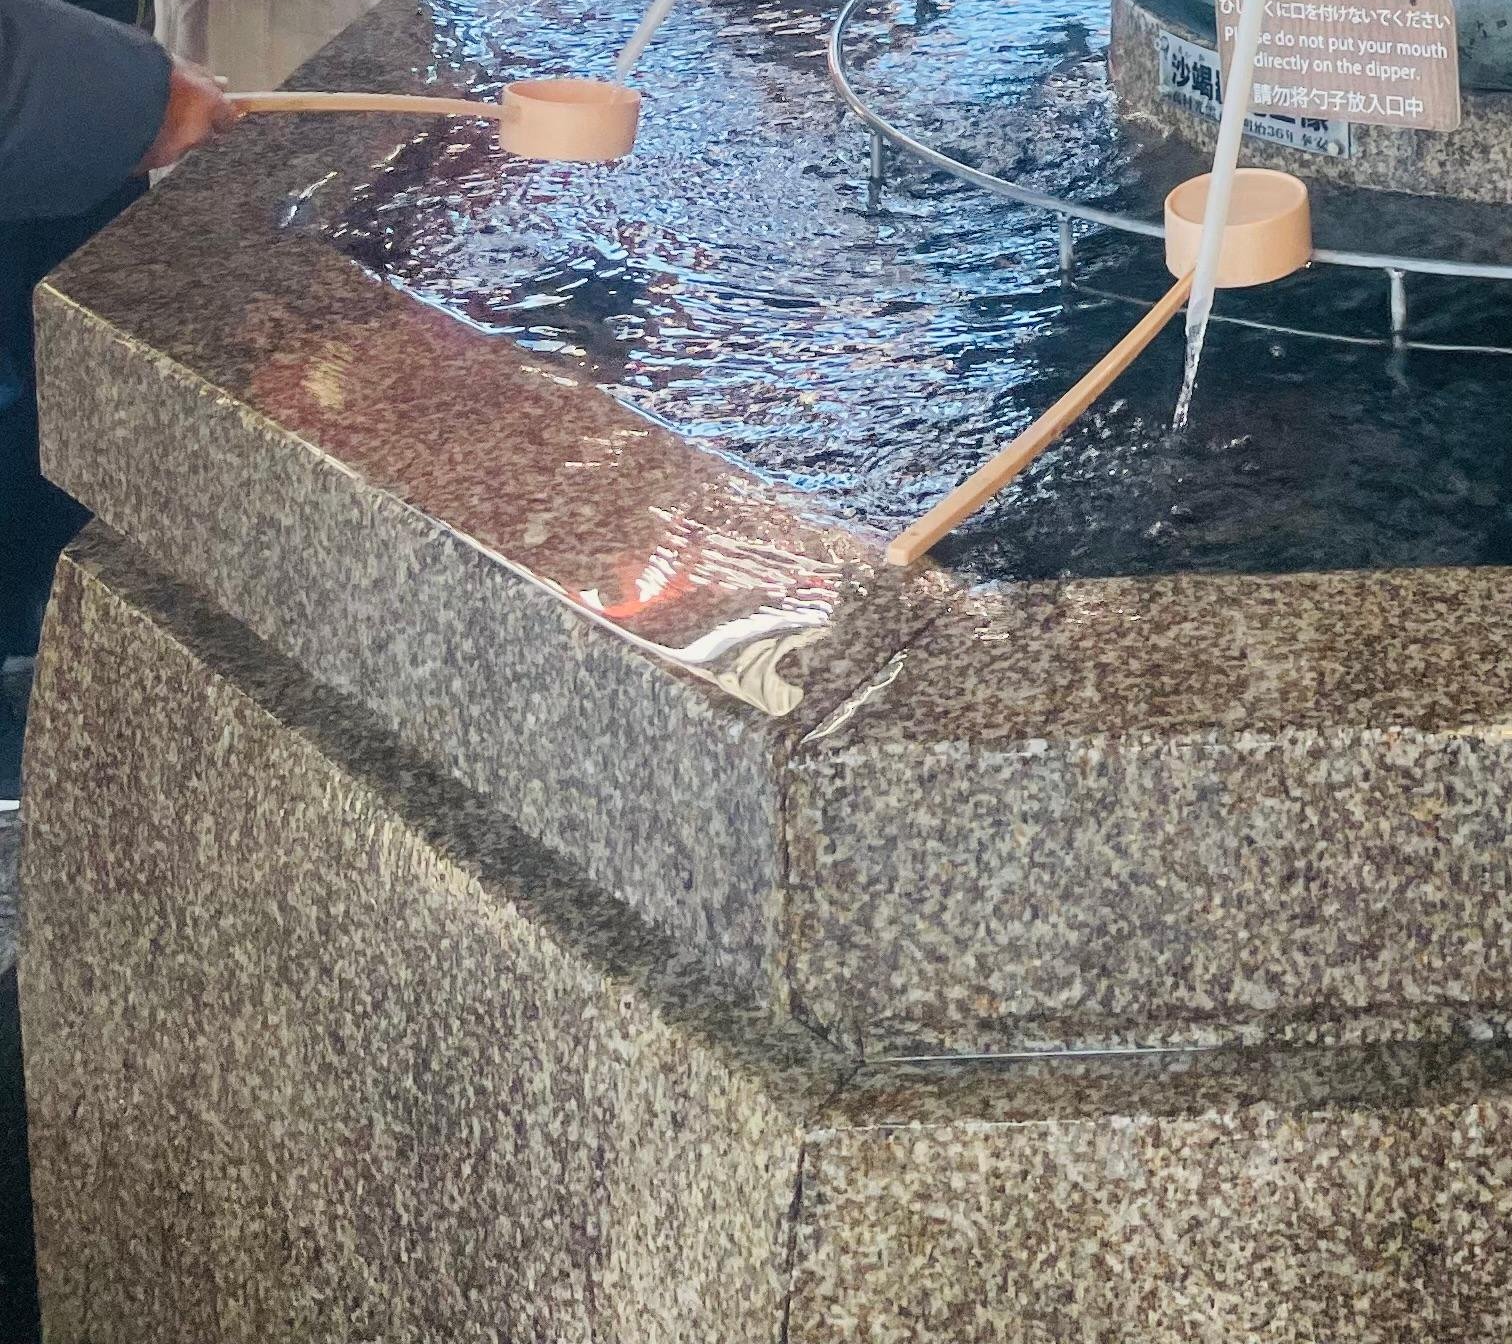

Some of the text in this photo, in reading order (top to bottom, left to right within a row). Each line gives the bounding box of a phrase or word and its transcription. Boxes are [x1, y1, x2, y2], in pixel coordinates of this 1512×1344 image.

[1225, 26, 1448, 59] Plse do not put your mouth
[1254, 51, 1421, 82] directly on the dipper.
